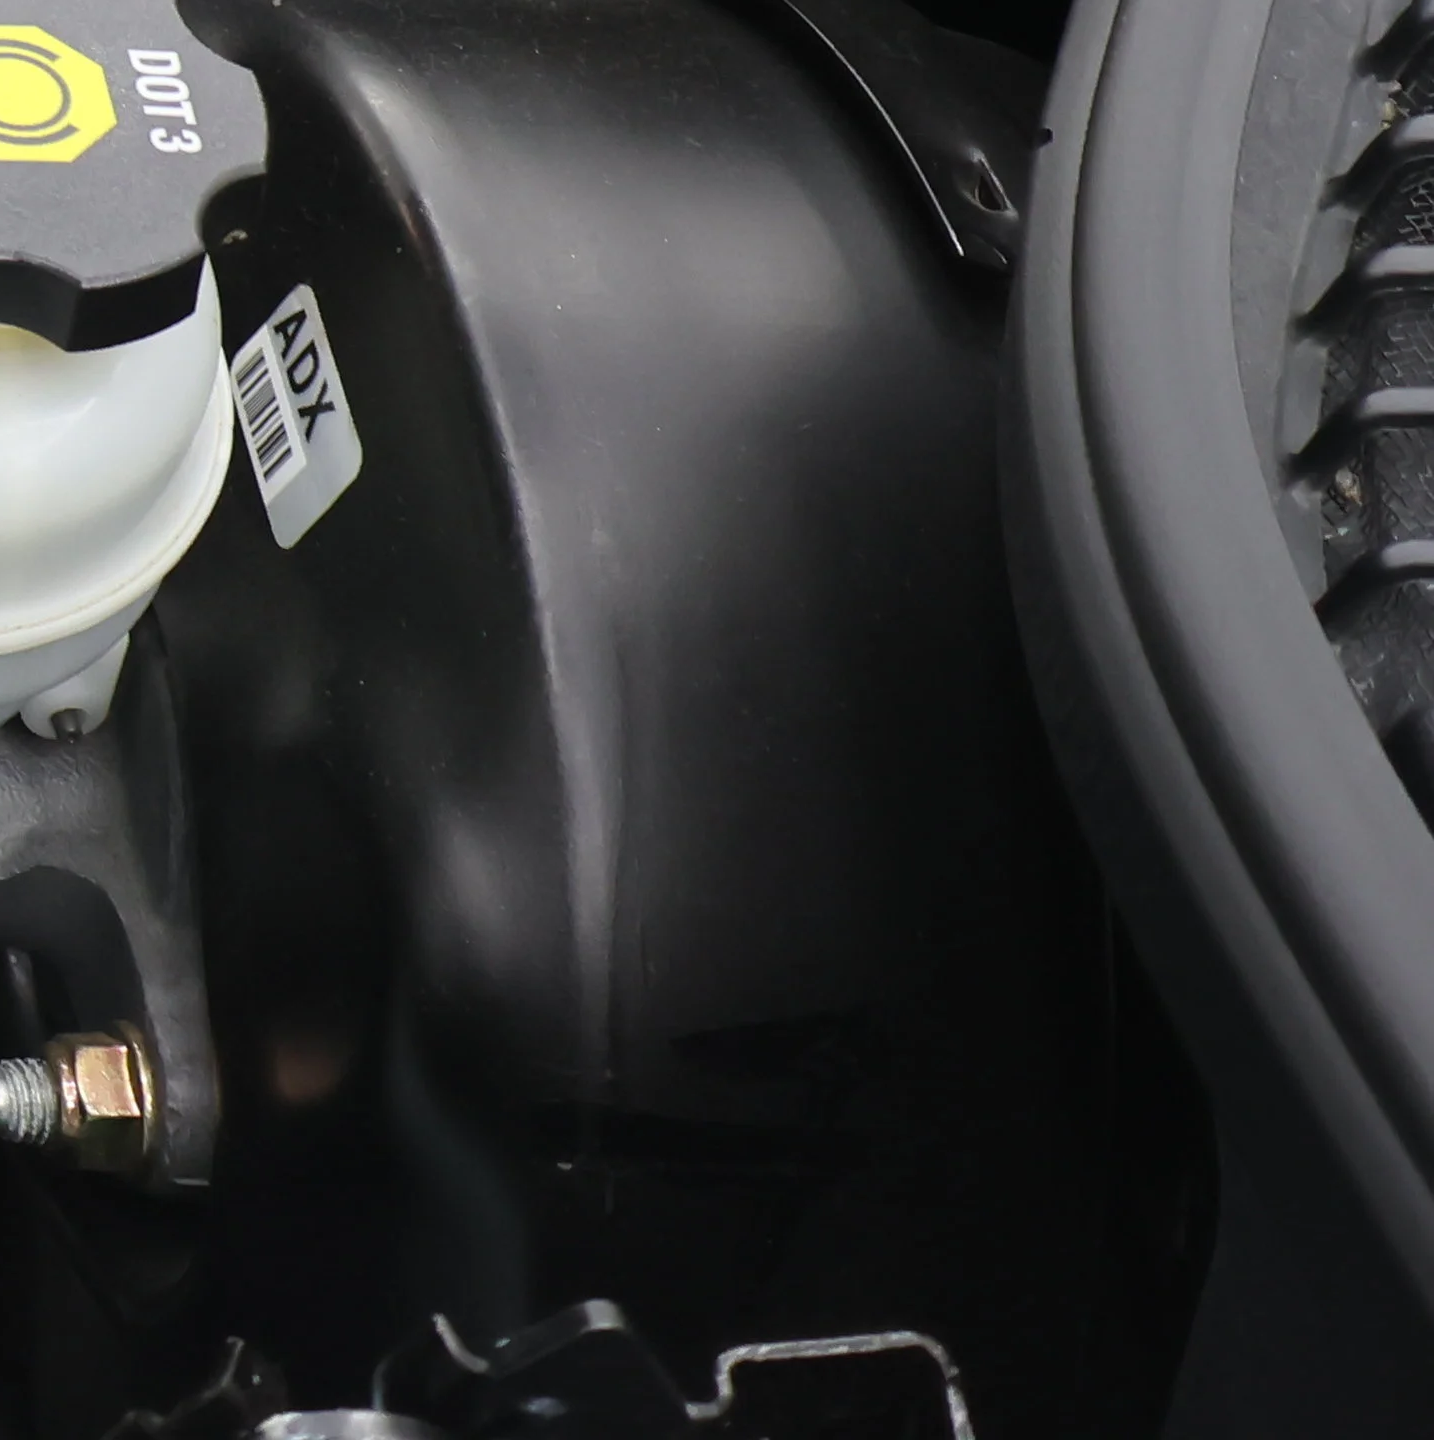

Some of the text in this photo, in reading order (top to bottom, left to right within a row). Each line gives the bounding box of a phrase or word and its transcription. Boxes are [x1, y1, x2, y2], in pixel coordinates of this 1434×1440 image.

[127, 48, 203, 156] DOT 3
[272, 308, 336, 443] ADX
